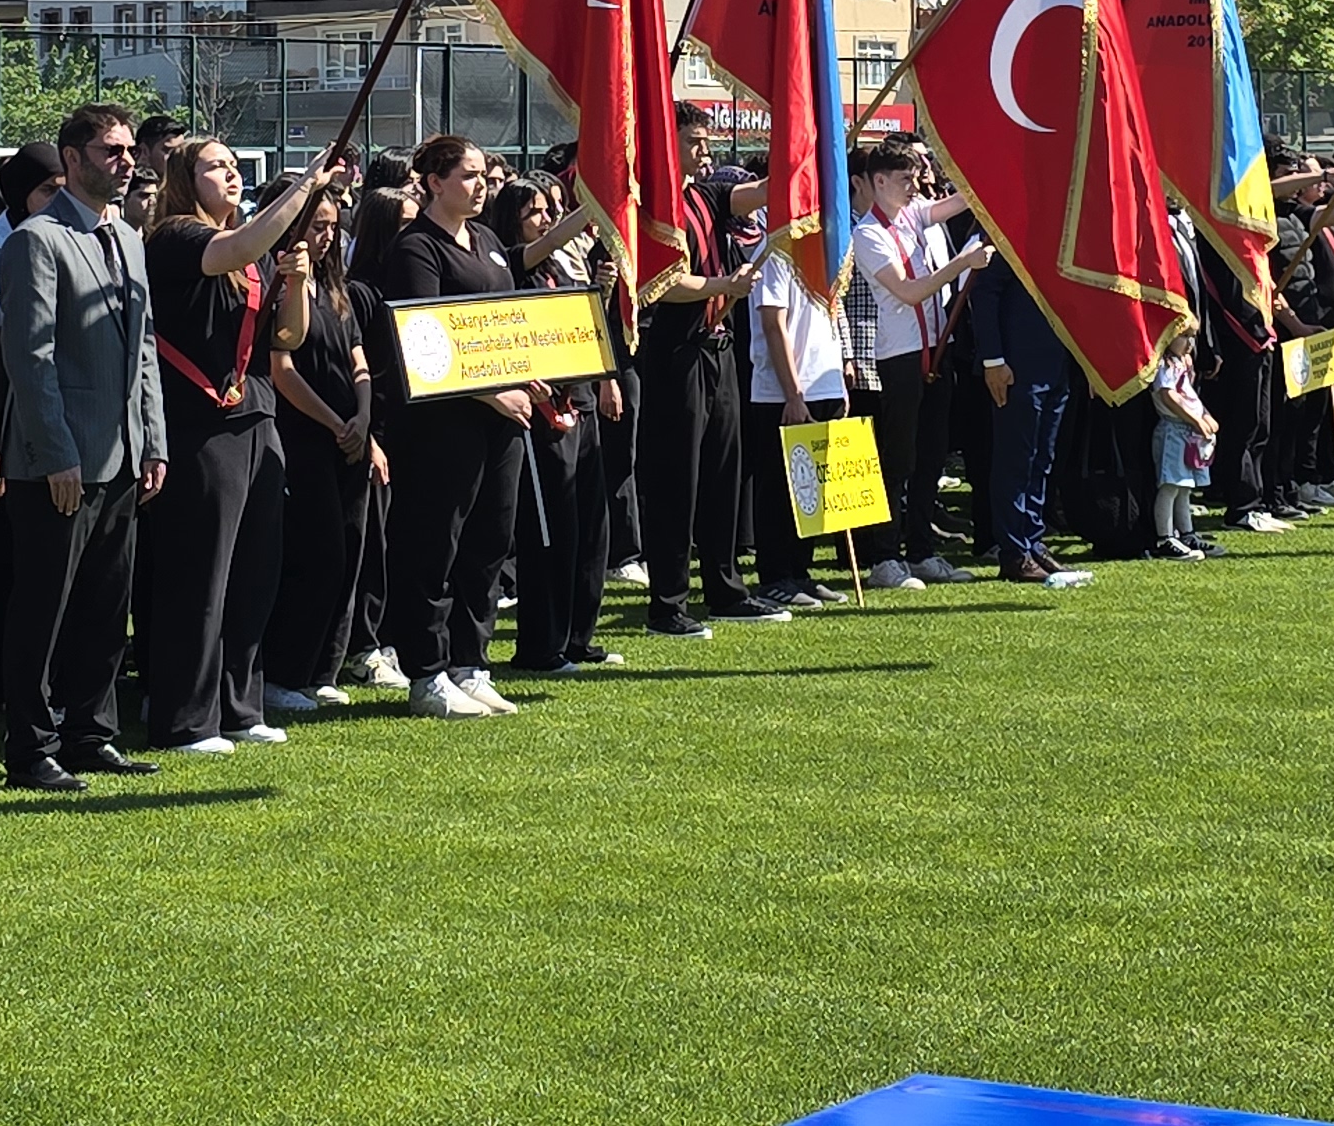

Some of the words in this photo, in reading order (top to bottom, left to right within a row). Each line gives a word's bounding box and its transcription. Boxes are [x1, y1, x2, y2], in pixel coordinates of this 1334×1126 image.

[529, 328, 565, 348] Mesleki
[461, 359, 501, 380] Anadolu
[502, 356, 532, 375] Lisesi
